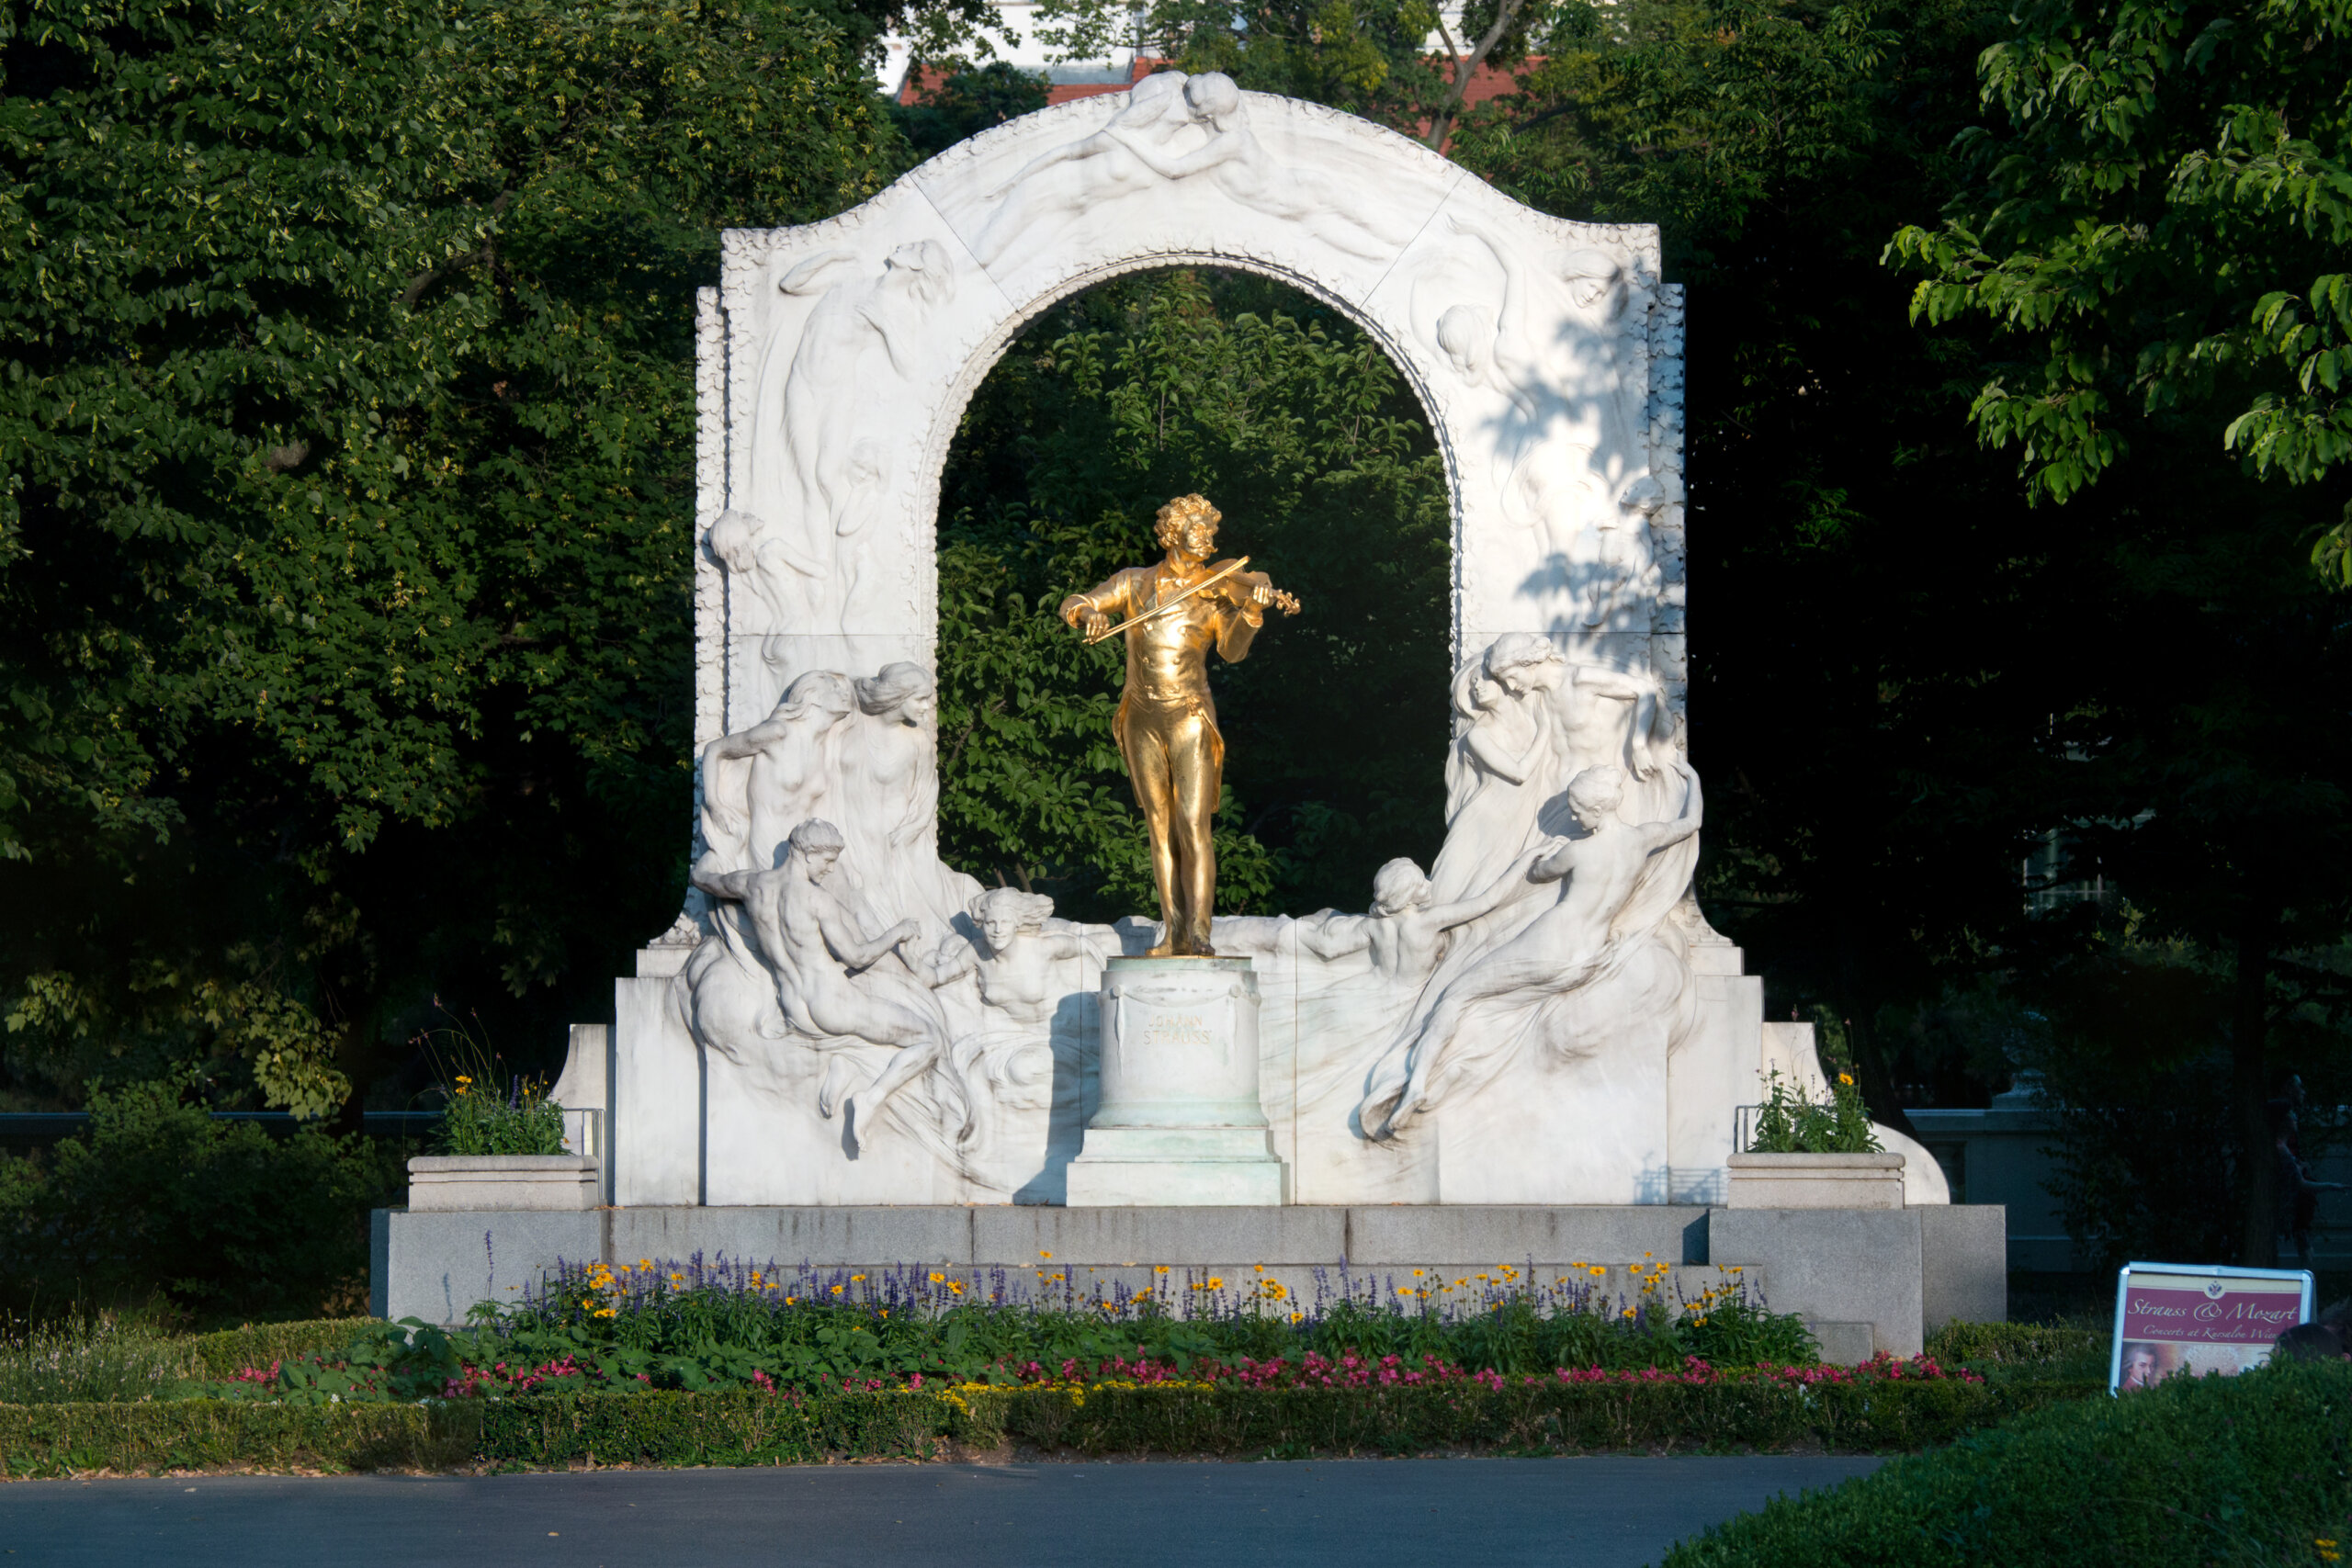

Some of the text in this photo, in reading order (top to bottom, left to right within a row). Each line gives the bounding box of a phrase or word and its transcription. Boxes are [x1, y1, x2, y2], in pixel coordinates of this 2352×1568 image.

[2127, 1298, 2297, 1325] Strauss & Mozart
[2143, 1324, 2185, 1337] Concerts
[2187, 1327, 2198, 1337] at
[2200, 1325, 2246, 1339] Kursalon
